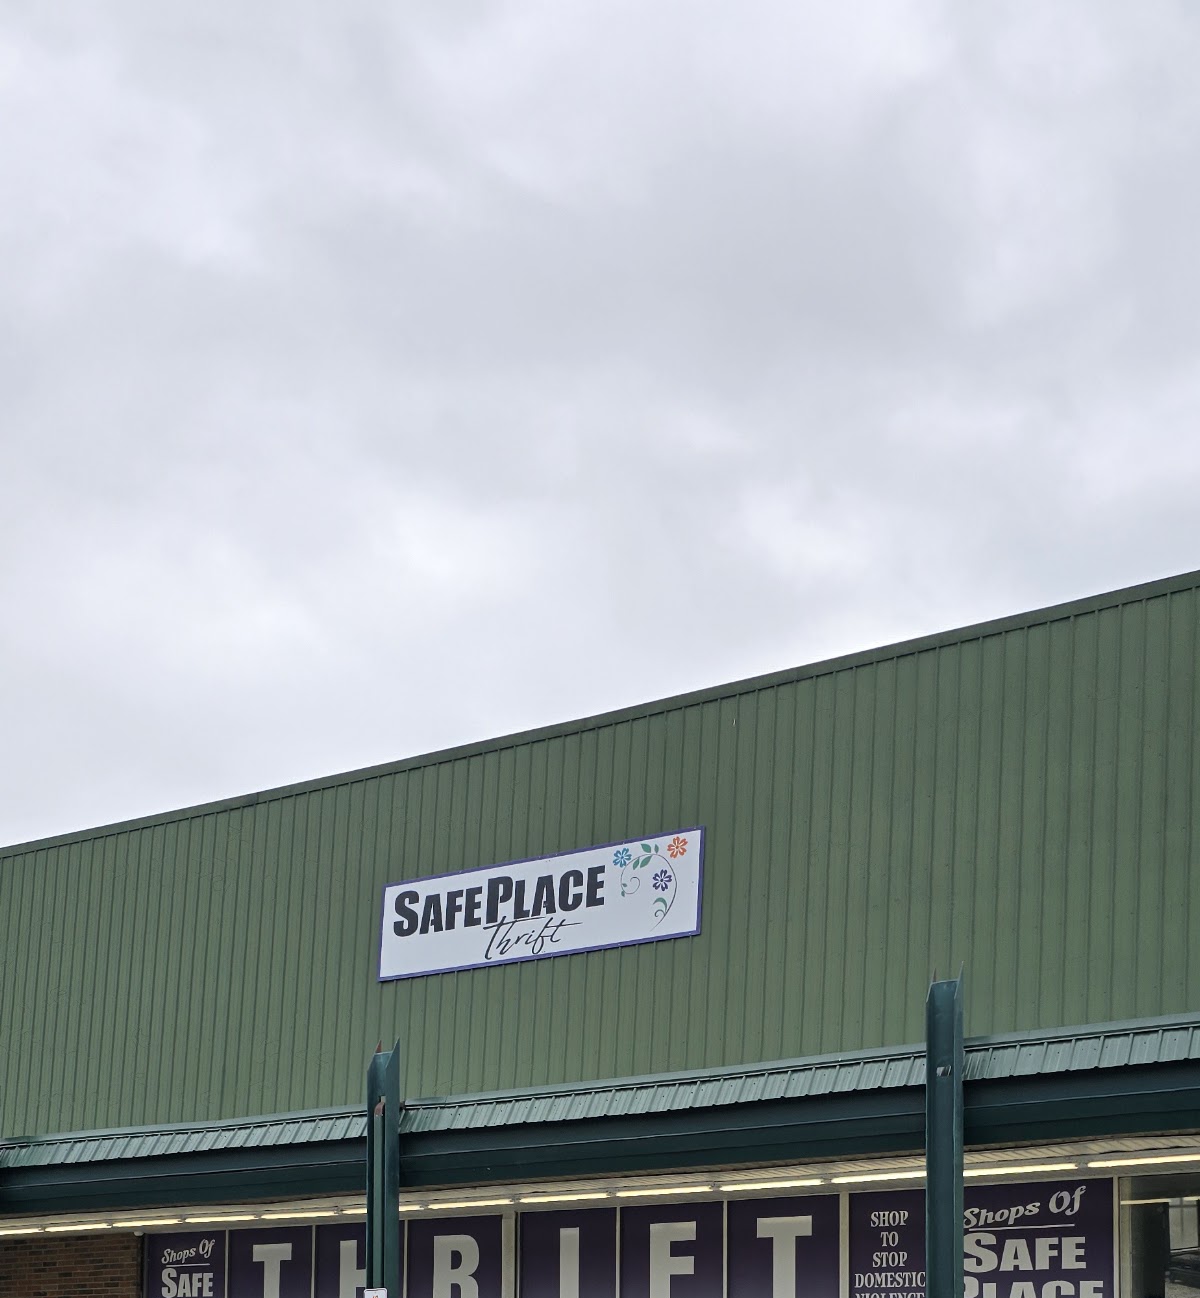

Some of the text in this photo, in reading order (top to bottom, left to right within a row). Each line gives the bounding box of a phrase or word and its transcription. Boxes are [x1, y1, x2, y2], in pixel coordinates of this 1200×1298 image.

[964, 1185, 1087, 1229] Shops Of
[870, 1210, 909, 1228] SHOP
[880, 1231, 899, 1247] TO
[161, 1238, 216, 1264] Shops Of
[872, 1251, 908, 1268] STOP
[964, 1232, 1087, 1273] SAFE
[161, 1267, 214, 1298] SAFE
[854, 1271, 926, 1288] DOMESTIC
